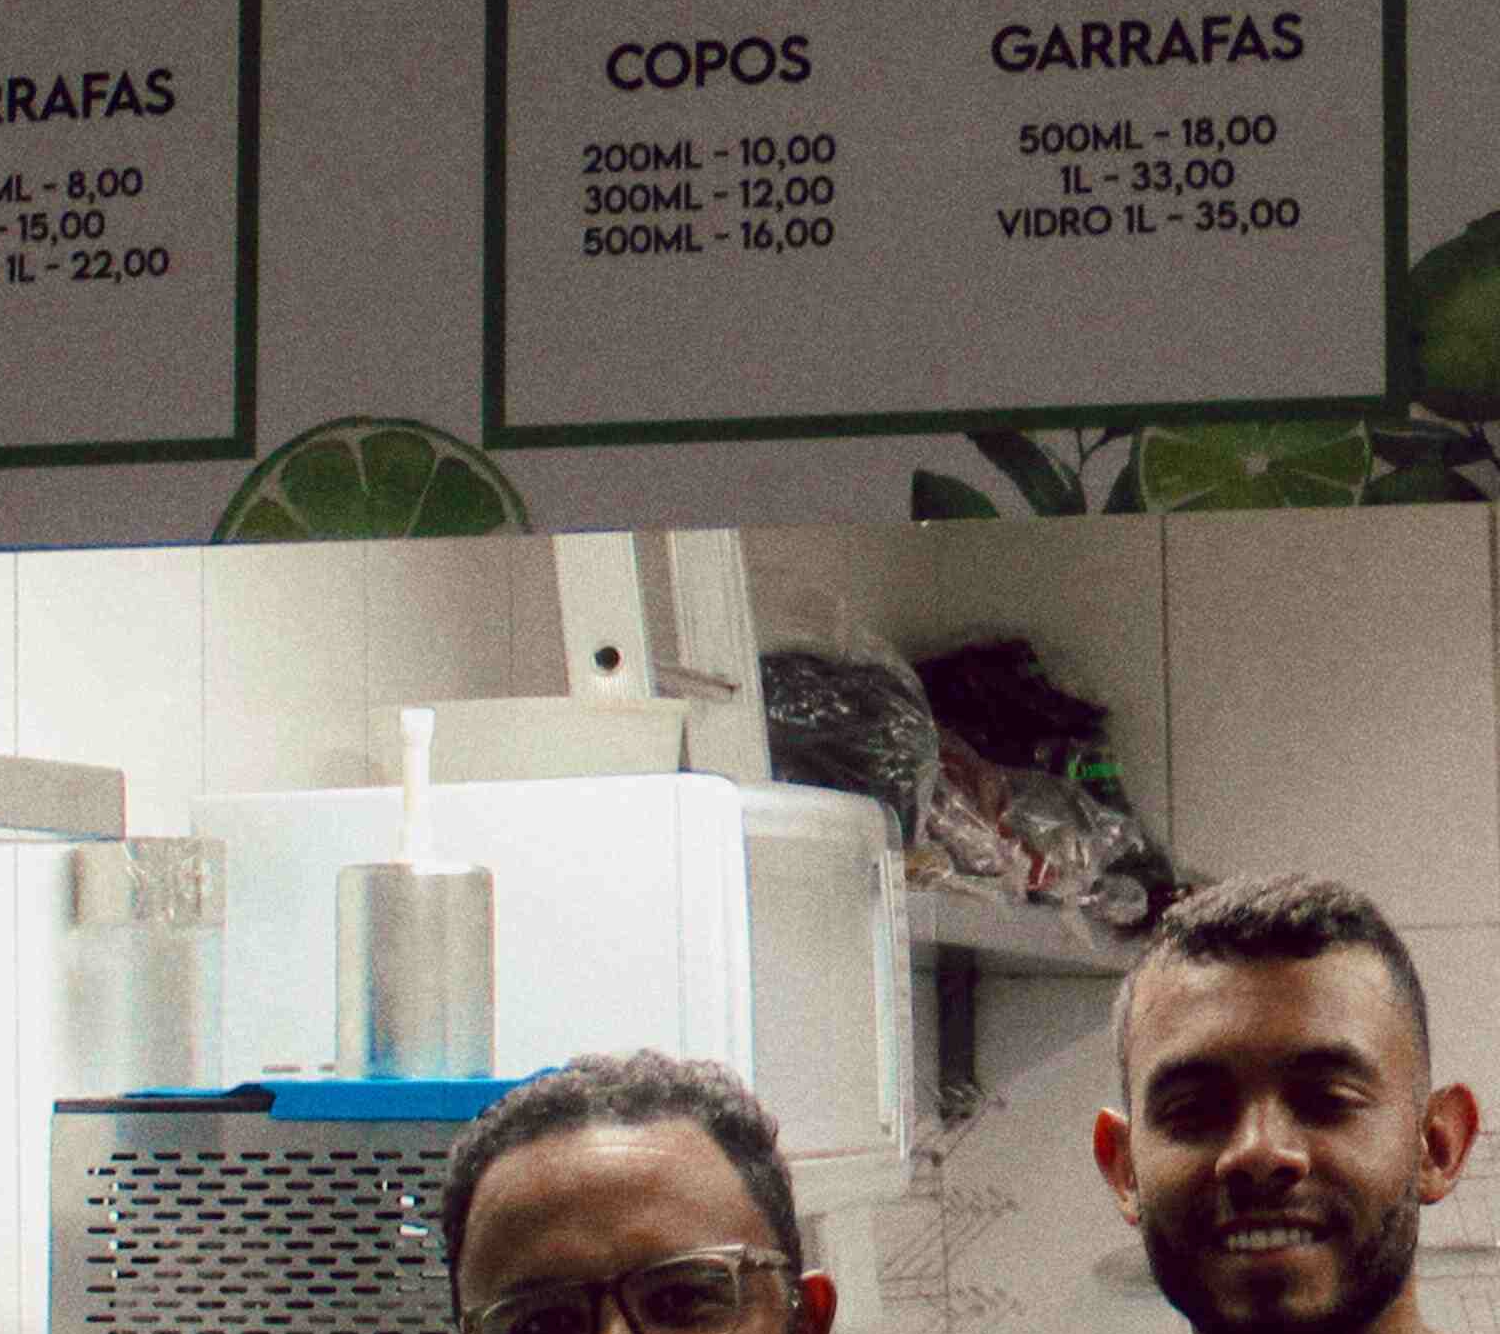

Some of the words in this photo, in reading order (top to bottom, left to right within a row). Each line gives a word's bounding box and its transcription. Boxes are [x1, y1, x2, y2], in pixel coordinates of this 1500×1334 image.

[605, 34, 812, 93] COPOS
[990, 11, 1305, 74] GARRAFAS
[582, 139, 703, 175] 200ML
[739, 132, 837, 169] 10,00
[1018, 119, 1144, 156] 500ML
[1181, 113, 1278, 151] 18,00
[66, 166, 144, 203] 8,00
[583, 181, 704, 216] 300ML
[739, 174, 835, 212] 12,00
[1060, 165, 1093, 195] 1L
[1130, 158, 1236, 196] 33,00
[17, 209, 106, 246] 15,00
[583, 223, 704, 258] 500ML
[740, 216, 836, 255] 16,00
[996, 204, 1114, 239] VIDRO
[1123, 203, 1157, 235] 1L
[1194, 196, 1301, 236] 35,00
[6, 253, 36, 285] 1L
[70, 246, 171, 285] 22,00
